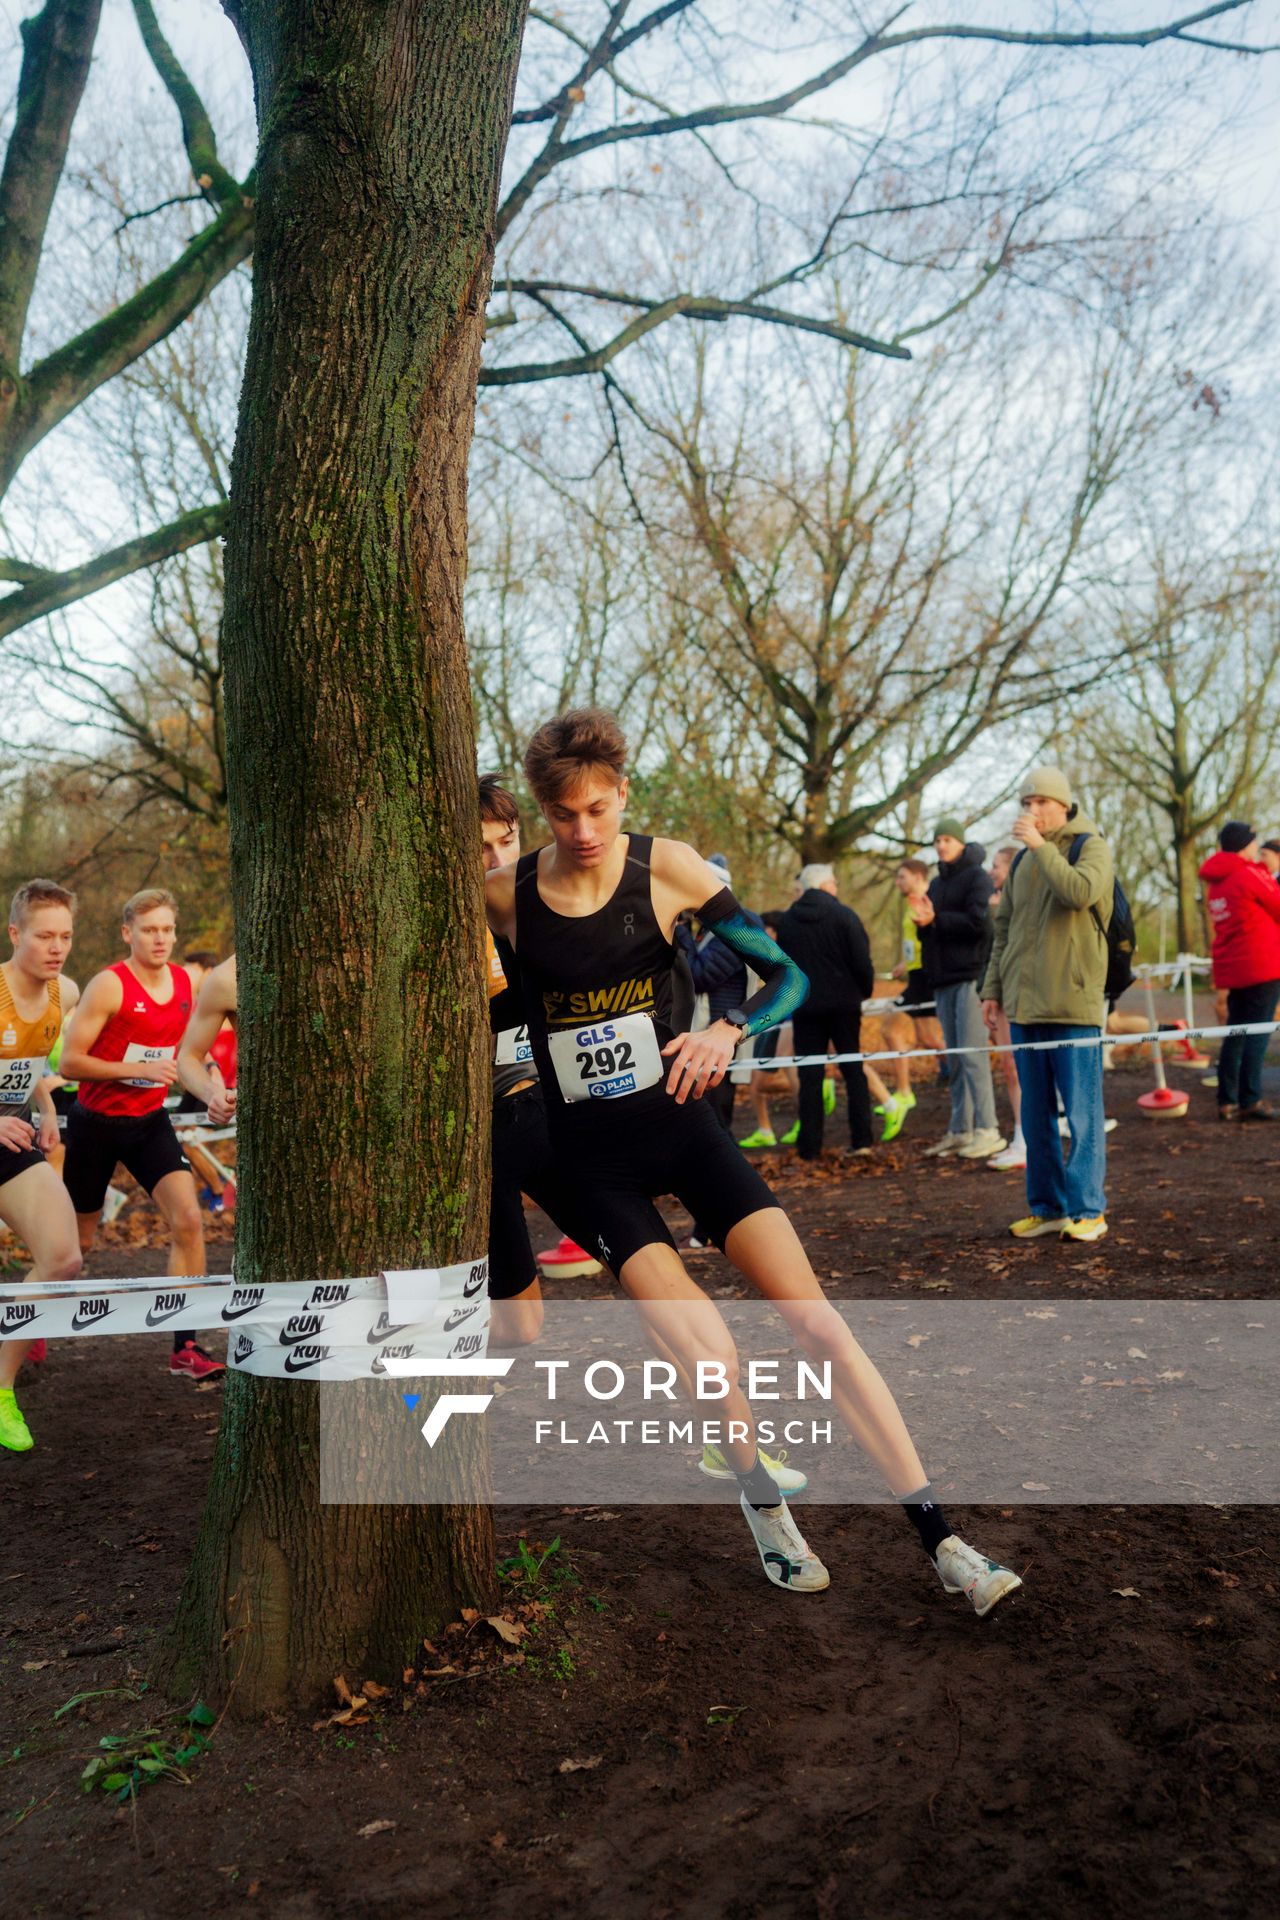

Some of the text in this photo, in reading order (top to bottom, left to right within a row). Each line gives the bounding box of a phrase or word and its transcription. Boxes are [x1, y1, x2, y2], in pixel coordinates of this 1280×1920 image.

[144, 1050, 162, 1059] GLS
[575, 1041, 637, 1080] 292
[10, 1060, 30, 1071] GLS
[0, 1072, 32, 1090] 232
[607, 1075, 633, 1091] PLAN
[154, 1293, 186, 1312] RUN
[229, 1288, 265, 1306] RUN
[311, 1284, 351, 1304] RUN
[6, 1303, 36, 1321] RUN
[78, 1298, 110, 1316] RUN
[286, 1314, 325, 1333] RUN
[238, 1334, 254, 1353] RUN
[293, 1344, 330, 1360] RUN
[453, 1334, 483, 1353] RUN
